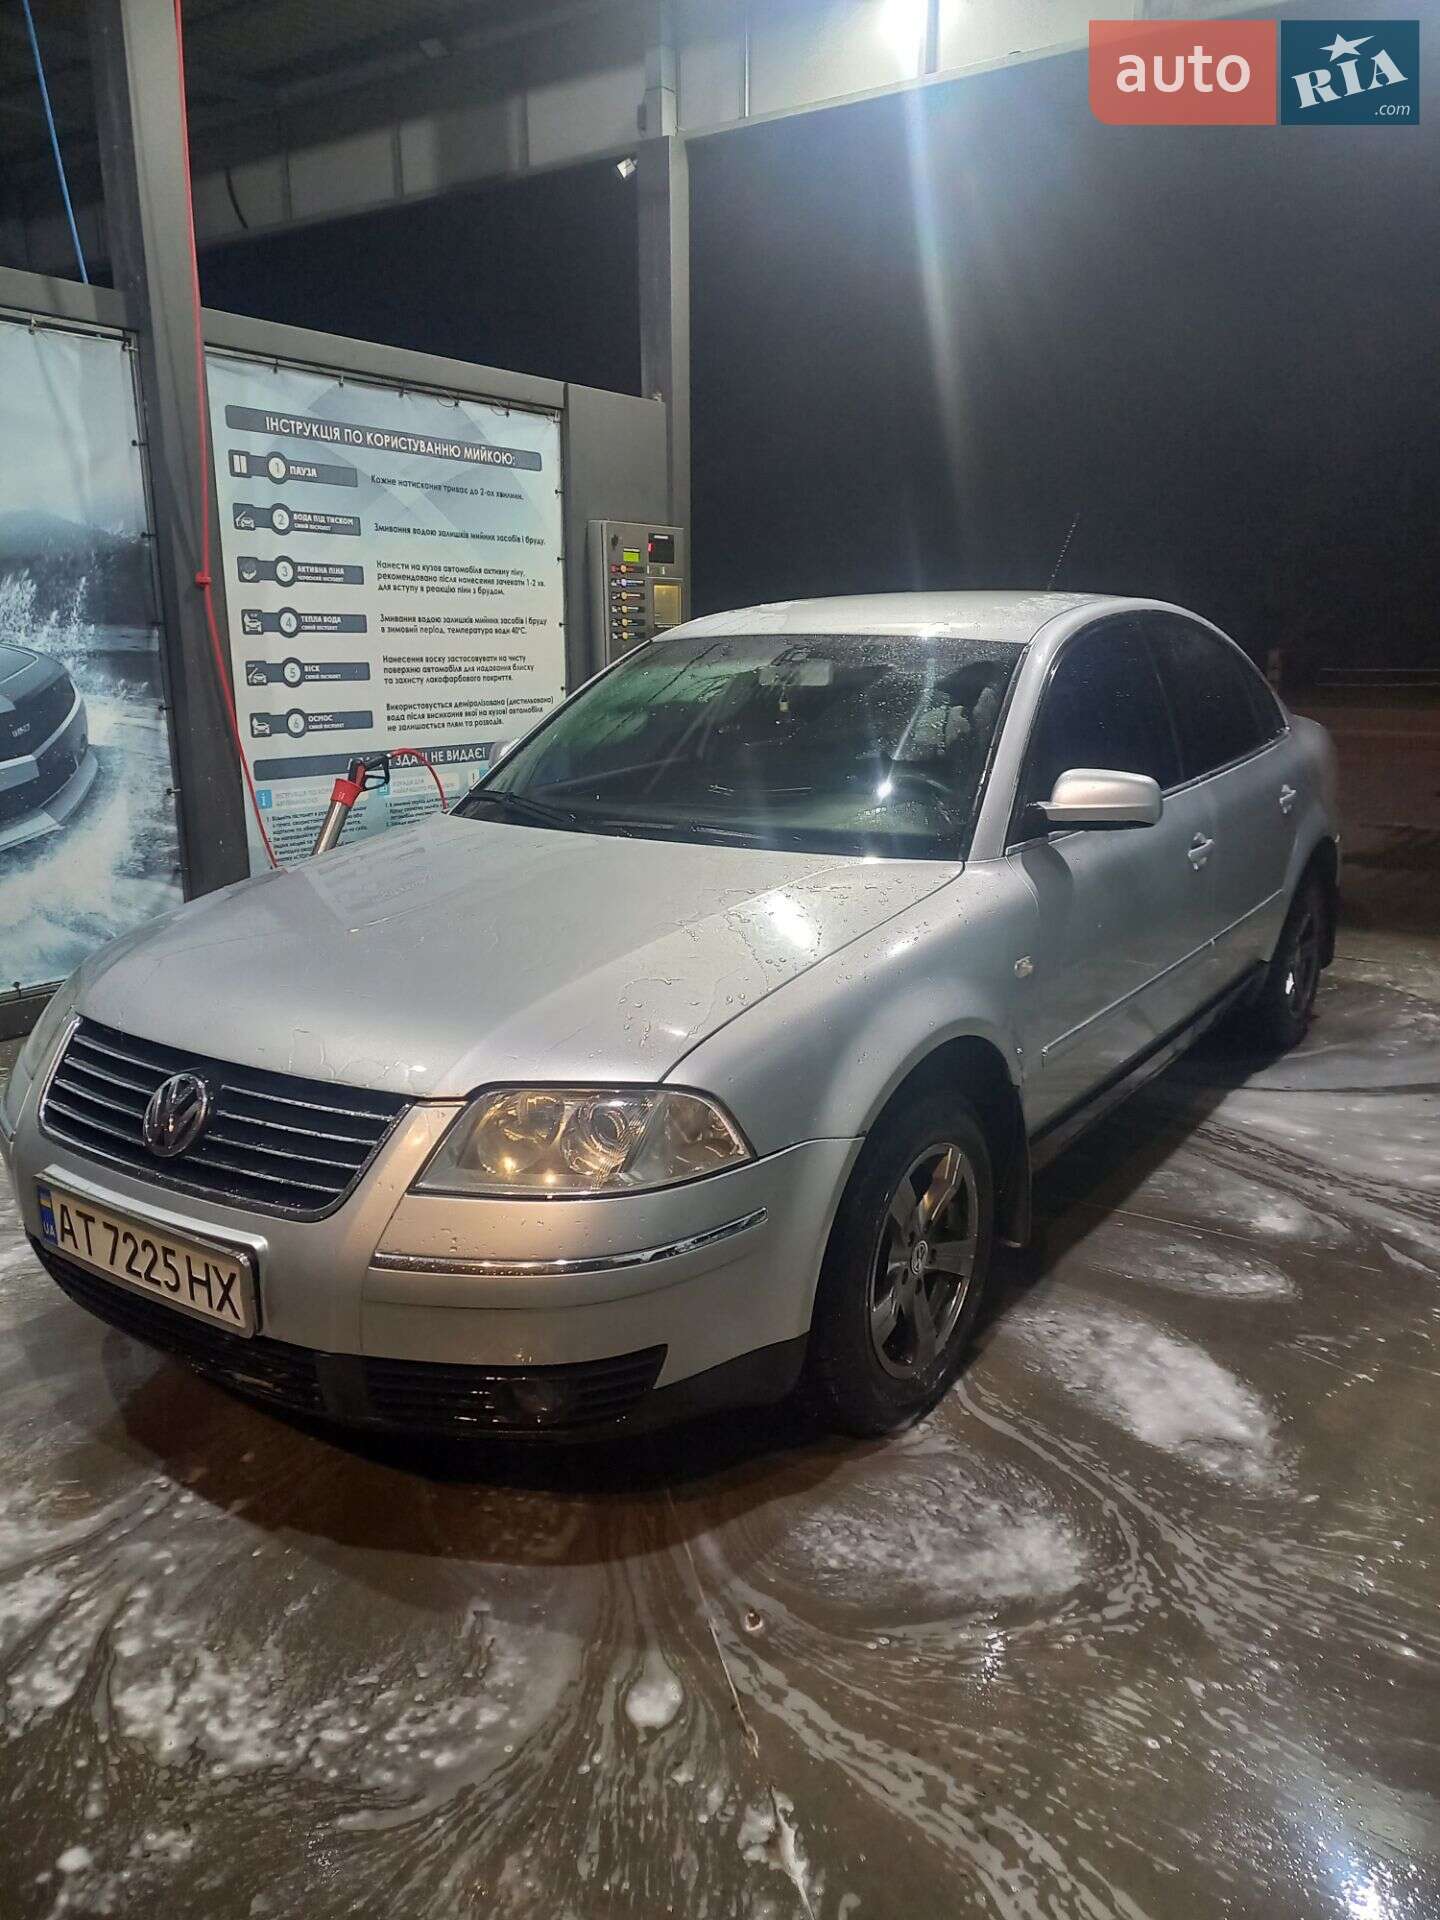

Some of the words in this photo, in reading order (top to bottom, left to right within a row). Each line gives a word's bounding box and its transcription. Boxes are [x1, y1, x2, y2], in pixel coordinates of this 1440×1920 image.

[265, 416, 340, 442] ІНСТРУКЦІЯ
[343, 428, 363, 444] ПО
[366, 432, 461, 458] КОРИСТУВАННЮ
[464, 447, 516, 466] МИЙКОЮ:
[289, 465, 318, 478] ПАУЗА
[371, 475, 396, 486] Кожне
[293, 513, 312, 522] ВОДА
[297, 566, 327, 574] АКТИВНА
[376, 560, 409, 570] Нанести
[377, 573, 438, 582] рекомендовано
[285, 618, 292, 628] 4
[323, 616, 342, 624] ВОДА
[431, 750, 445, 763] НЕ
[43, 1222, 57, 1236] UA
[59, 1203, 95, 1257] AT
[102, 1222, 181, 1293] 7225
[185, 1254, 241, 1321] HX
